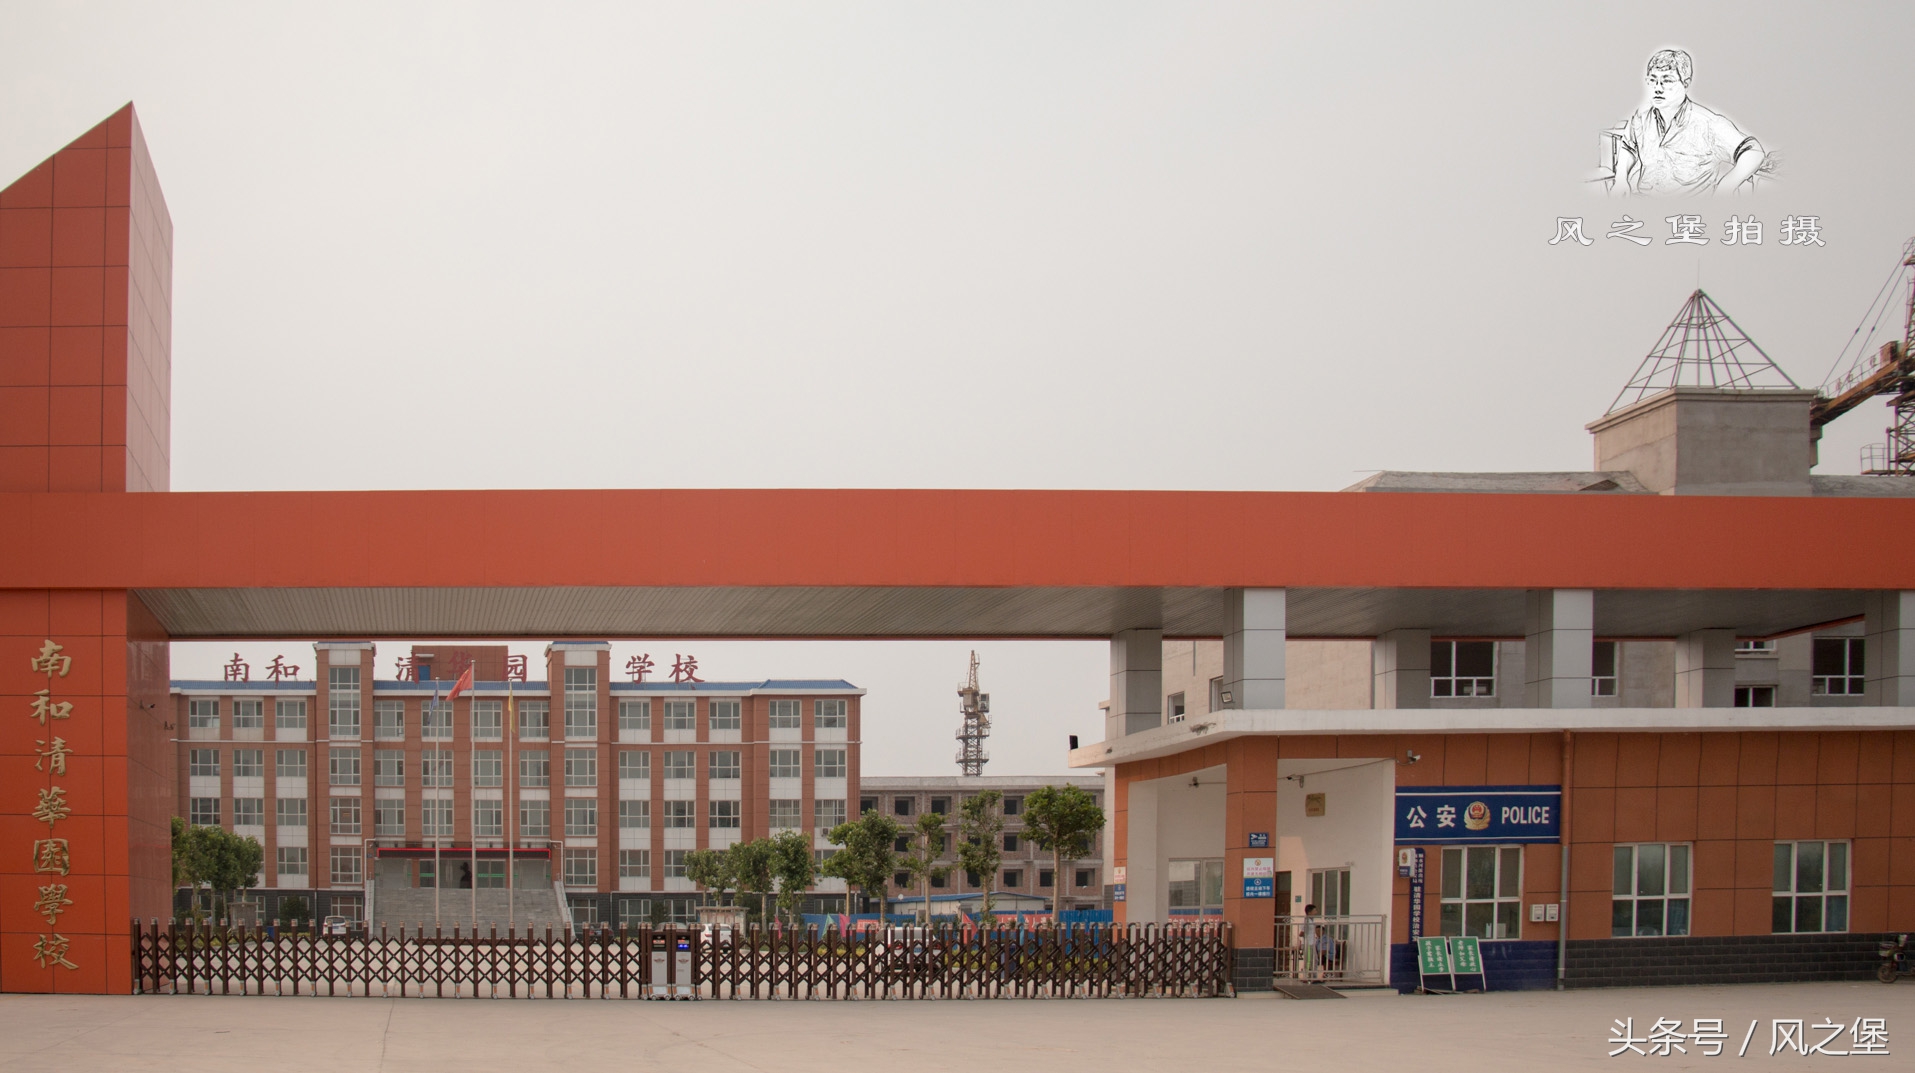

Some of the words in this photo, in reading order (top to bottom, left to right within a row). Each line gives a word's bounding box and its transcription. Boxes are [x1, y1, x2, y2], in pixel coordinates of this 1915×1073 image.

[30, 639, 79, 970] 南和清華園學校
[1406, 804, 1456, 828] 公安
[1501, 806, 1550, 825] POLICE
